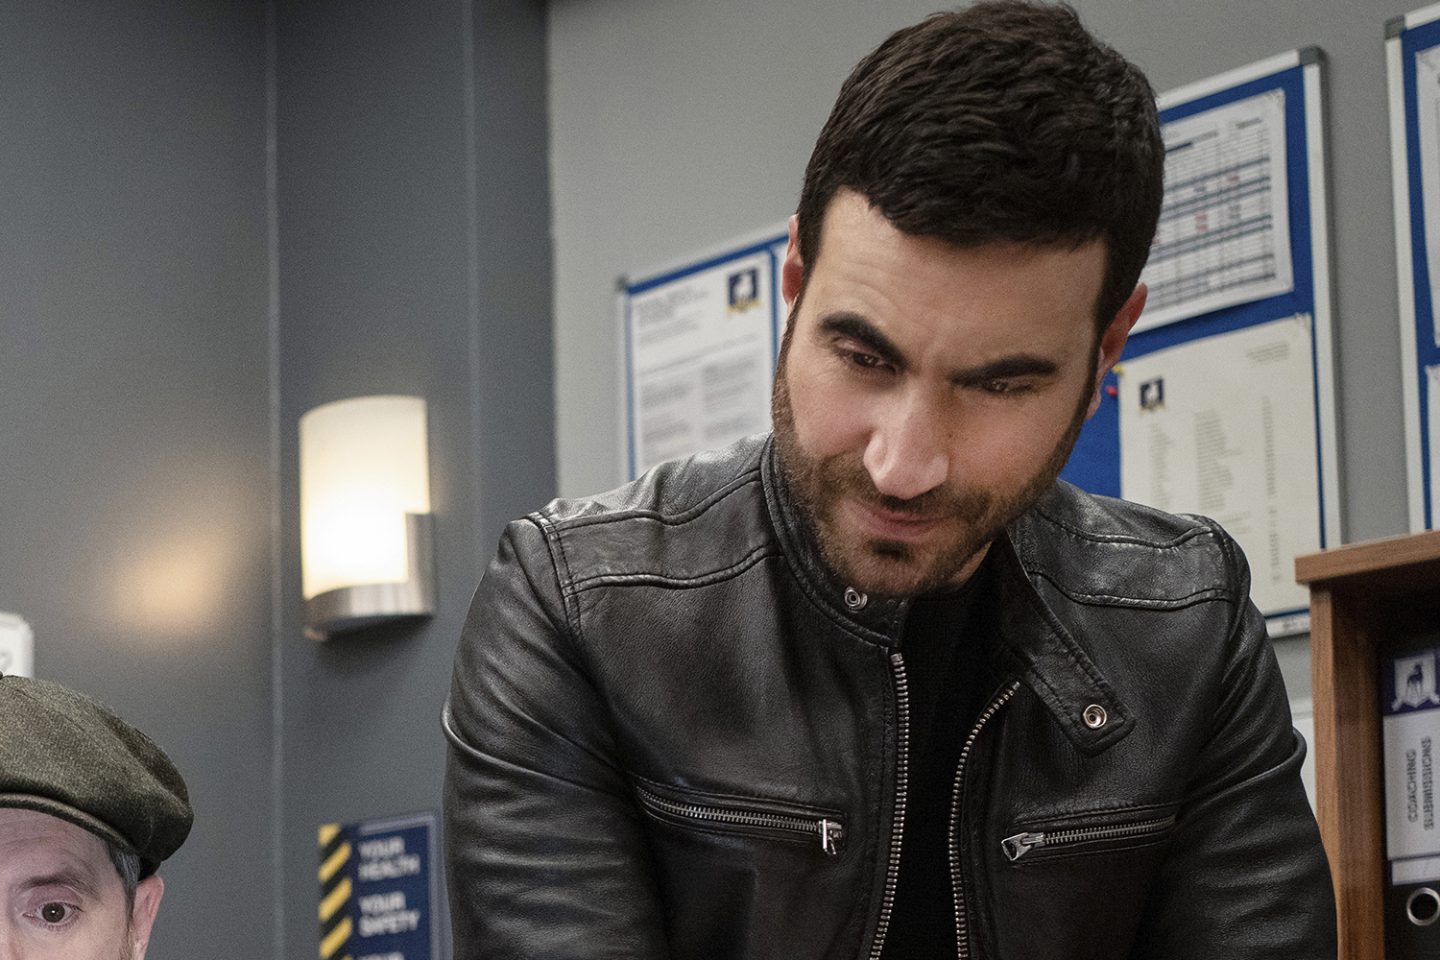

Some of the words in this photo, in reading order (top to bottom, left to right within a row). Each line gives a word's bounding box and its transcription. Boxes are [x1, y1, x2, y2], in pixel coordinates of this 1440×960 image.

[1406, 748, 1419, 824] COACHING
[359, 836, 405, 860] YOUR
[359, 854, 421, 882] HEALTH
[359, 891, 406, 914] YOUR
[360, 910, 421, 938] SAFETY
